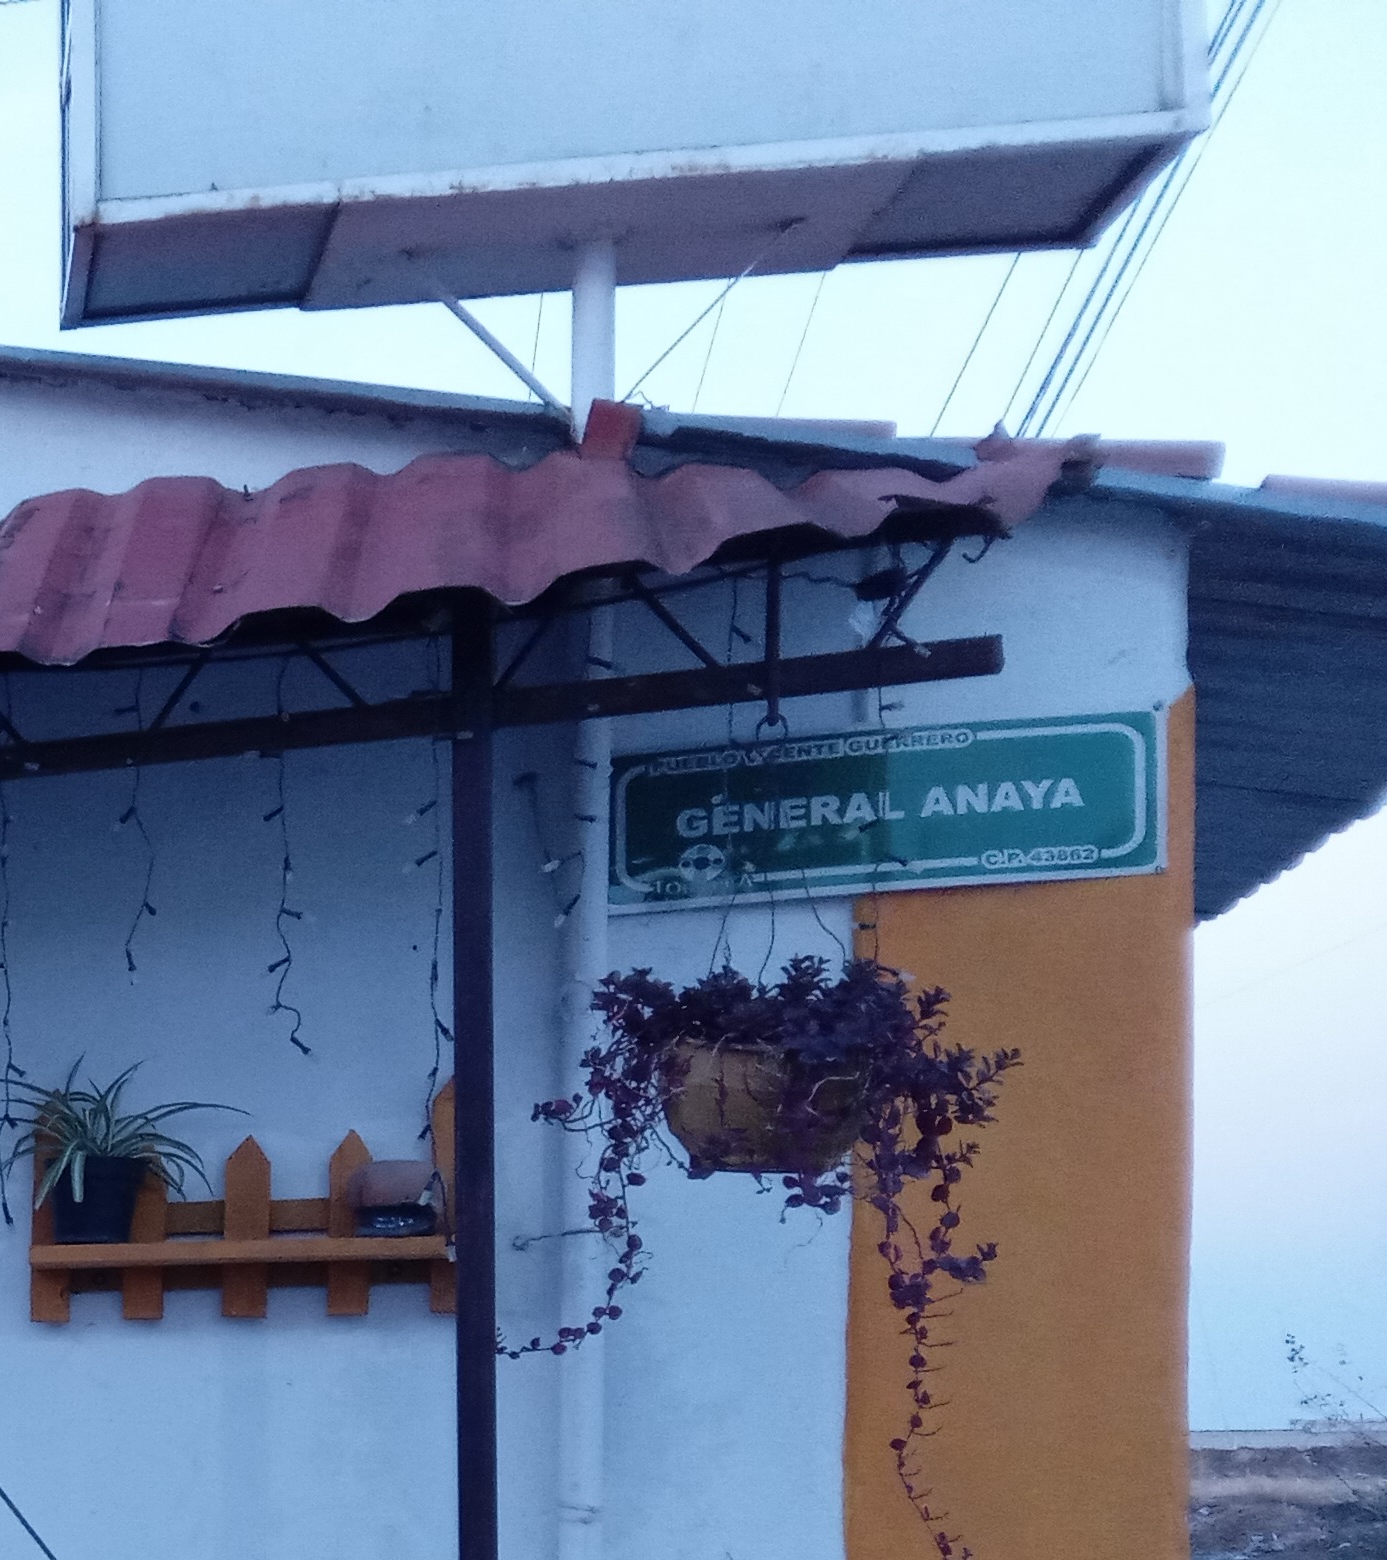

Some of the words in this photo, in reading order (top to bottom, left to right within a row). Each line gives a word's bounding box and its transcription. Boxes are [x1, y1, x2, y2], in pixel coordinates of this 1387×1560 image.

[676, 791, 905, 839] GENERAL
[920, 776, 1084, 818] ANAYA
[985, 850, 1023, 867] C.P.
